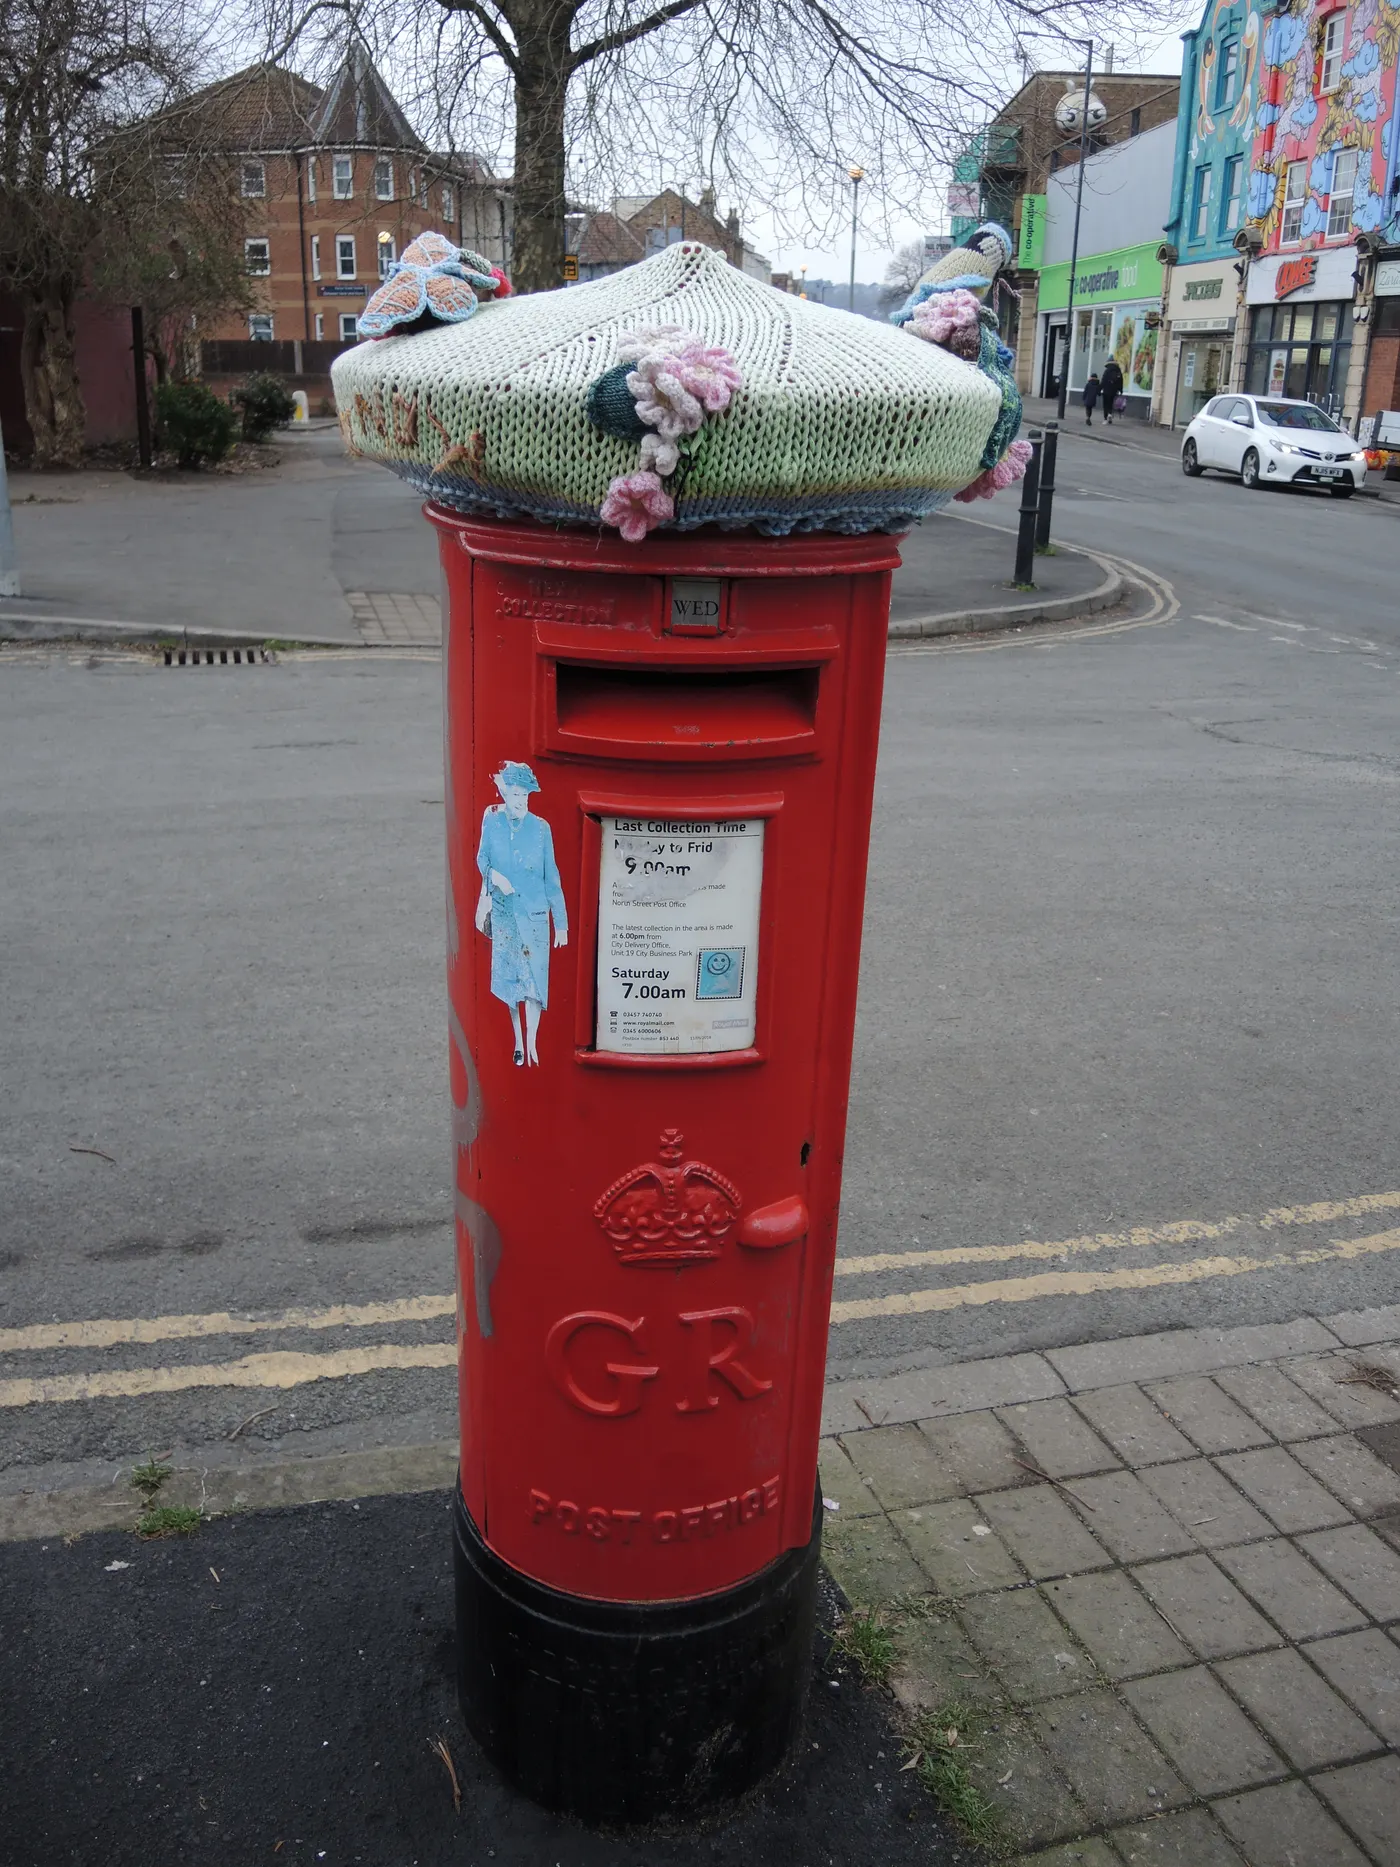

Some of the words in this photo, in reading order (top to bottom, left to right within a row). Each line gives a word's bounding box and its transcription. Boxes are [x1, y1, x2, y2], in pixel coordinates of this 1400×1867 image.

[1026, 197, 1036, 250] co-operative
[1079, 265, 1119, 298] co-operative
[1122, 259, 1139, 288] food
[503, 596, 614, 623] COLLECTION
[673, 600, 719, 616] WED
[614, 819, 643, 832] Last
[647, 821, 711, 834] Collection
[715, 820, 746, 833] Time
[632, 900, 652, 908] Street
[620, 933, 645, 941] 6.00pm
[611, 941, 623, 949] City
[624, 941, 651, 950] Delivery
[636, 950, 648, 958] City
[612, 967, 670, 980] Saturday
[622, 983, 686, 999] 7.00am
[527, 1487, 642, 1547] POST
[653, 1475, 781, 1543] OFFICE
